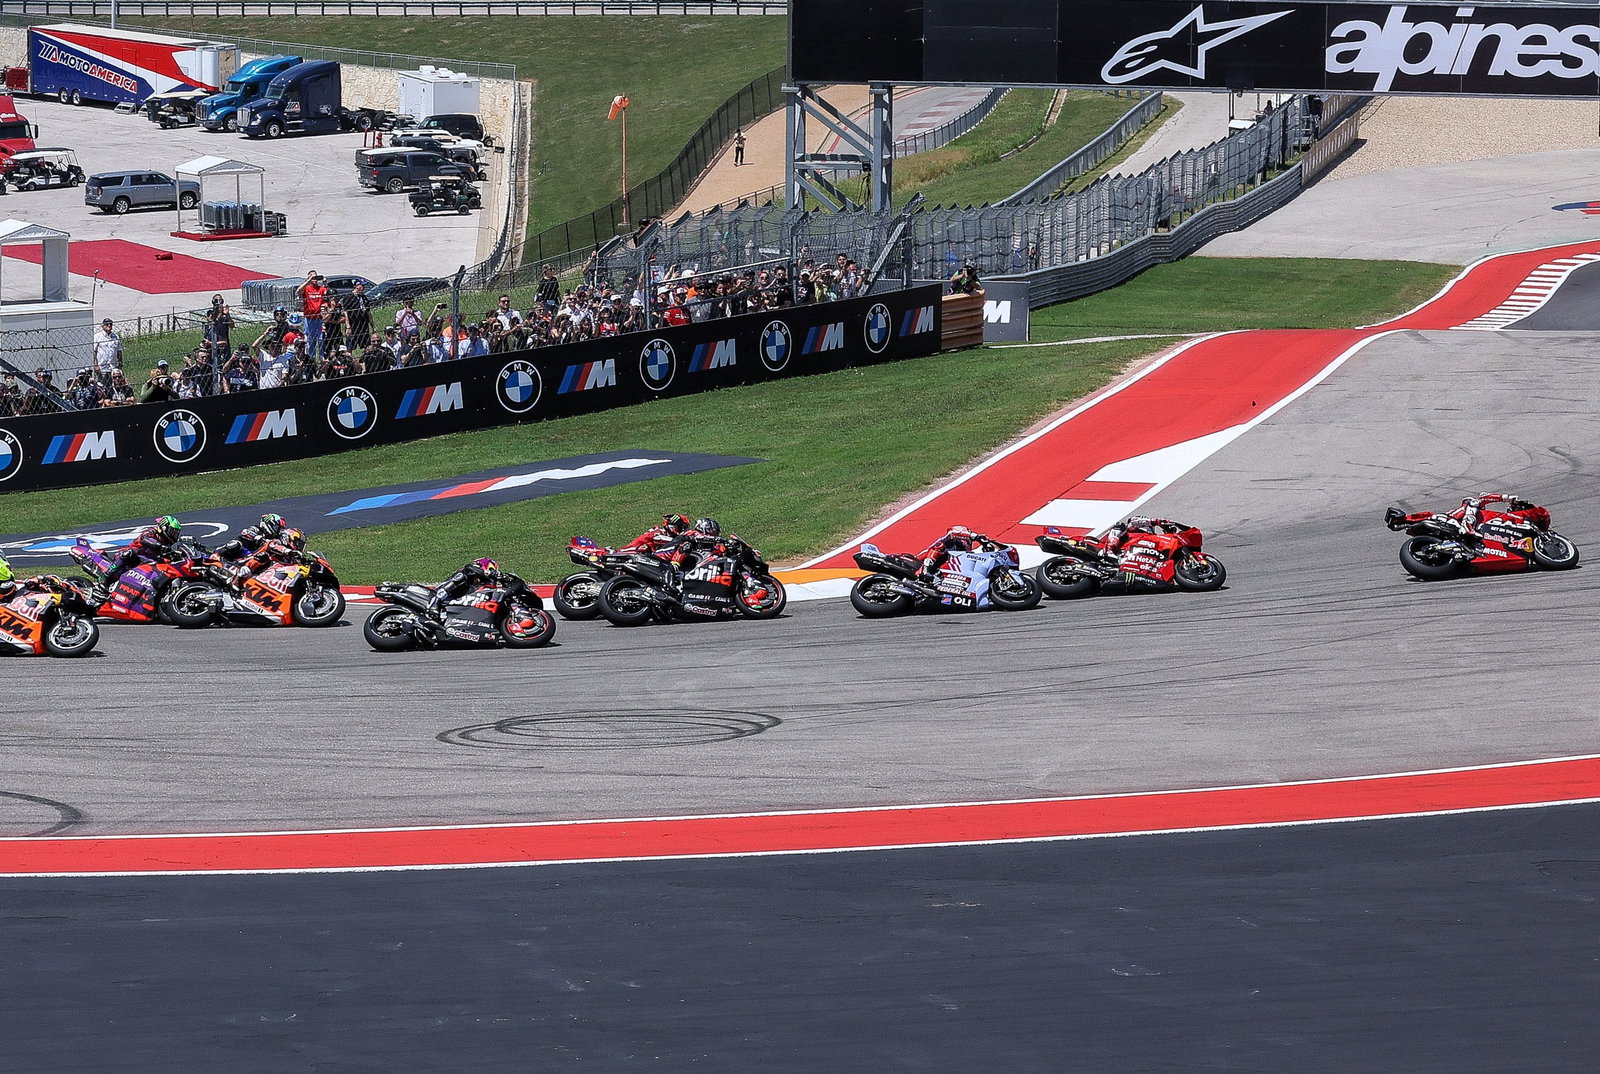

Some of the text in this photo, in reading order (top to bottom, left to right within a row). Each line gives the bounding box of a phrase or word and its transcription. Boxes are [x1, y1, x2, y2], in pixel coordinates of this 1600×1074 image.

[1325, 5, 1600, 92] alpines
[58, 50, 138, 94] MOTOAMERICA
[914, 305, 934, 334] M
[983, 300, 1011, 324] M
[821, 322, 844, 352] M
[709, 338, 737, 369] M
[584, 358, 617, 390] M
[425, 382, 464, 414] M
[257, 408, 297, 440] M
[74, 430, 117, 461] M
[966, 554, 987, 562] DUCATI
[1483, 548, 1508, 558] MOTUL
[245, 583, 283, 612] KTM
[453, 630, 480, 642] Castrol
